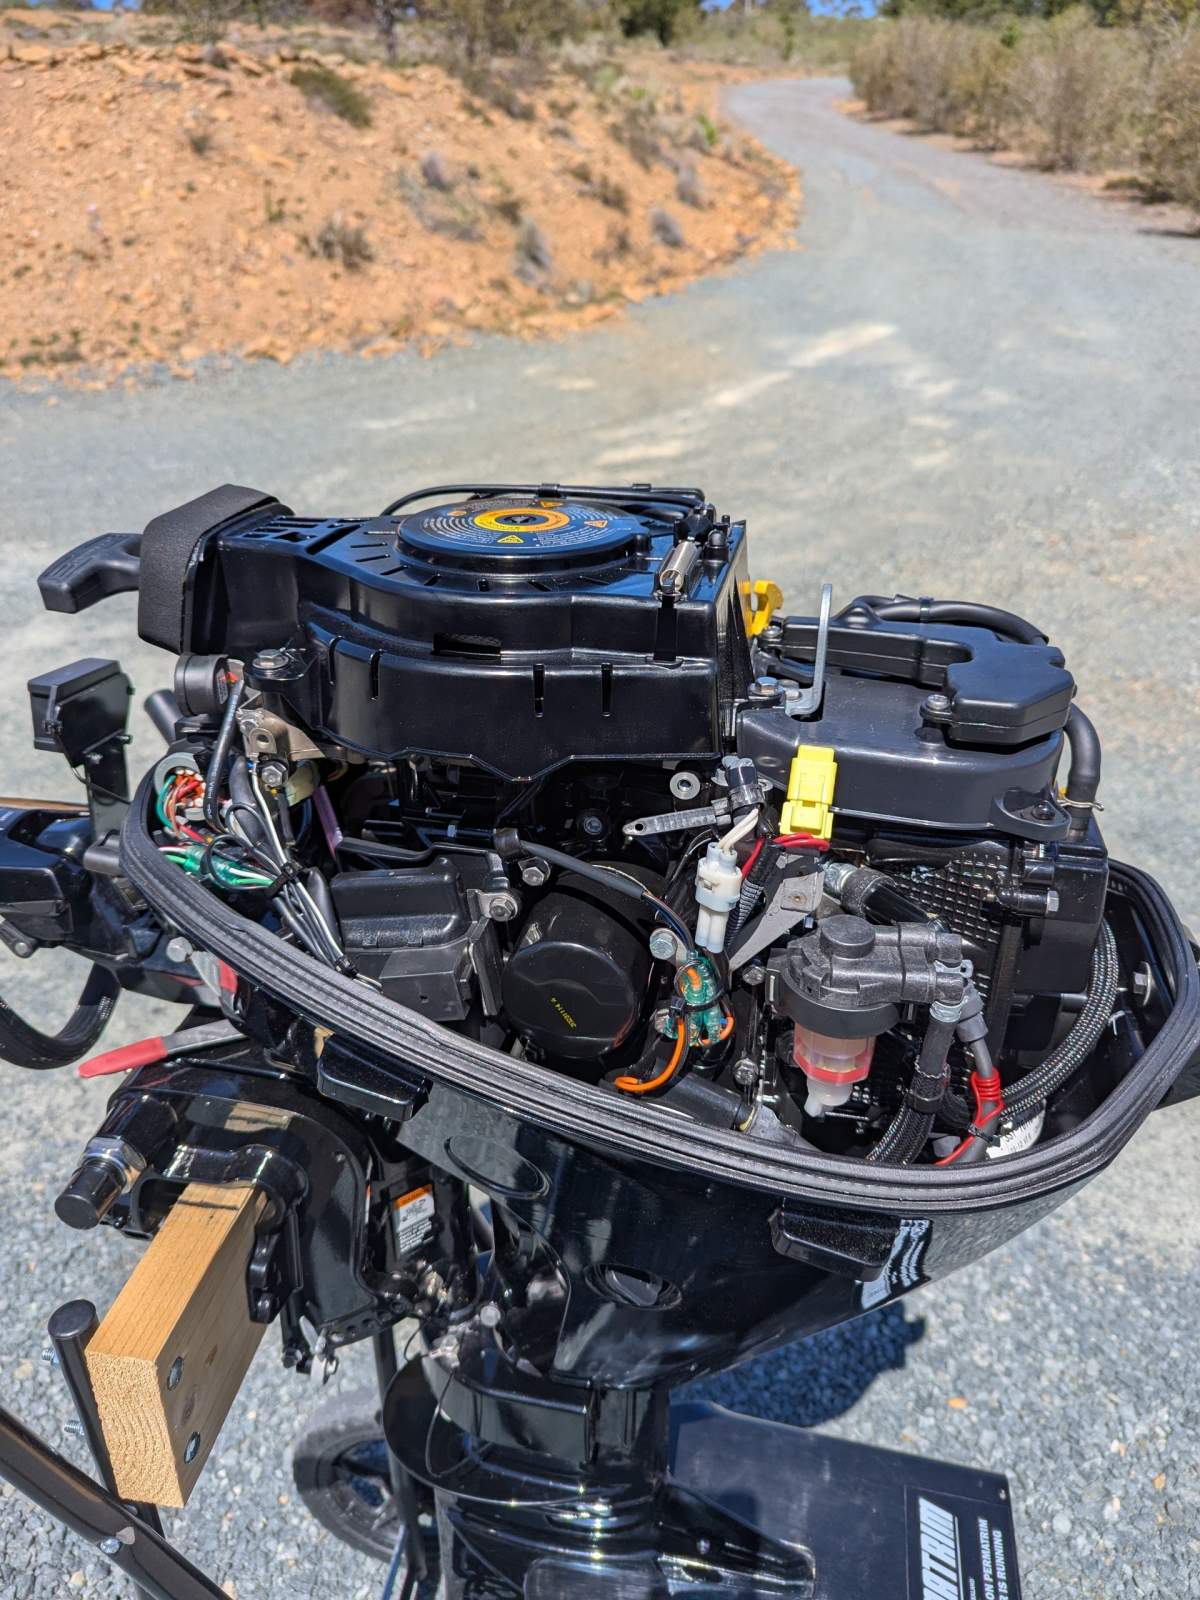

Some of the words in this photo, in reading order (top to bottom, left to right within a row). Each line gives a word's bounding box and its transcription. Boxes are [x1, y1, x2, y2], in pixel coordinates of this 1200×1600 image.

[979, 1517, 992, 1582] PERMATRIM
[993, 1530, 1006, 1579] RUNNING
[998, 1581, 1007, 1593] IS
